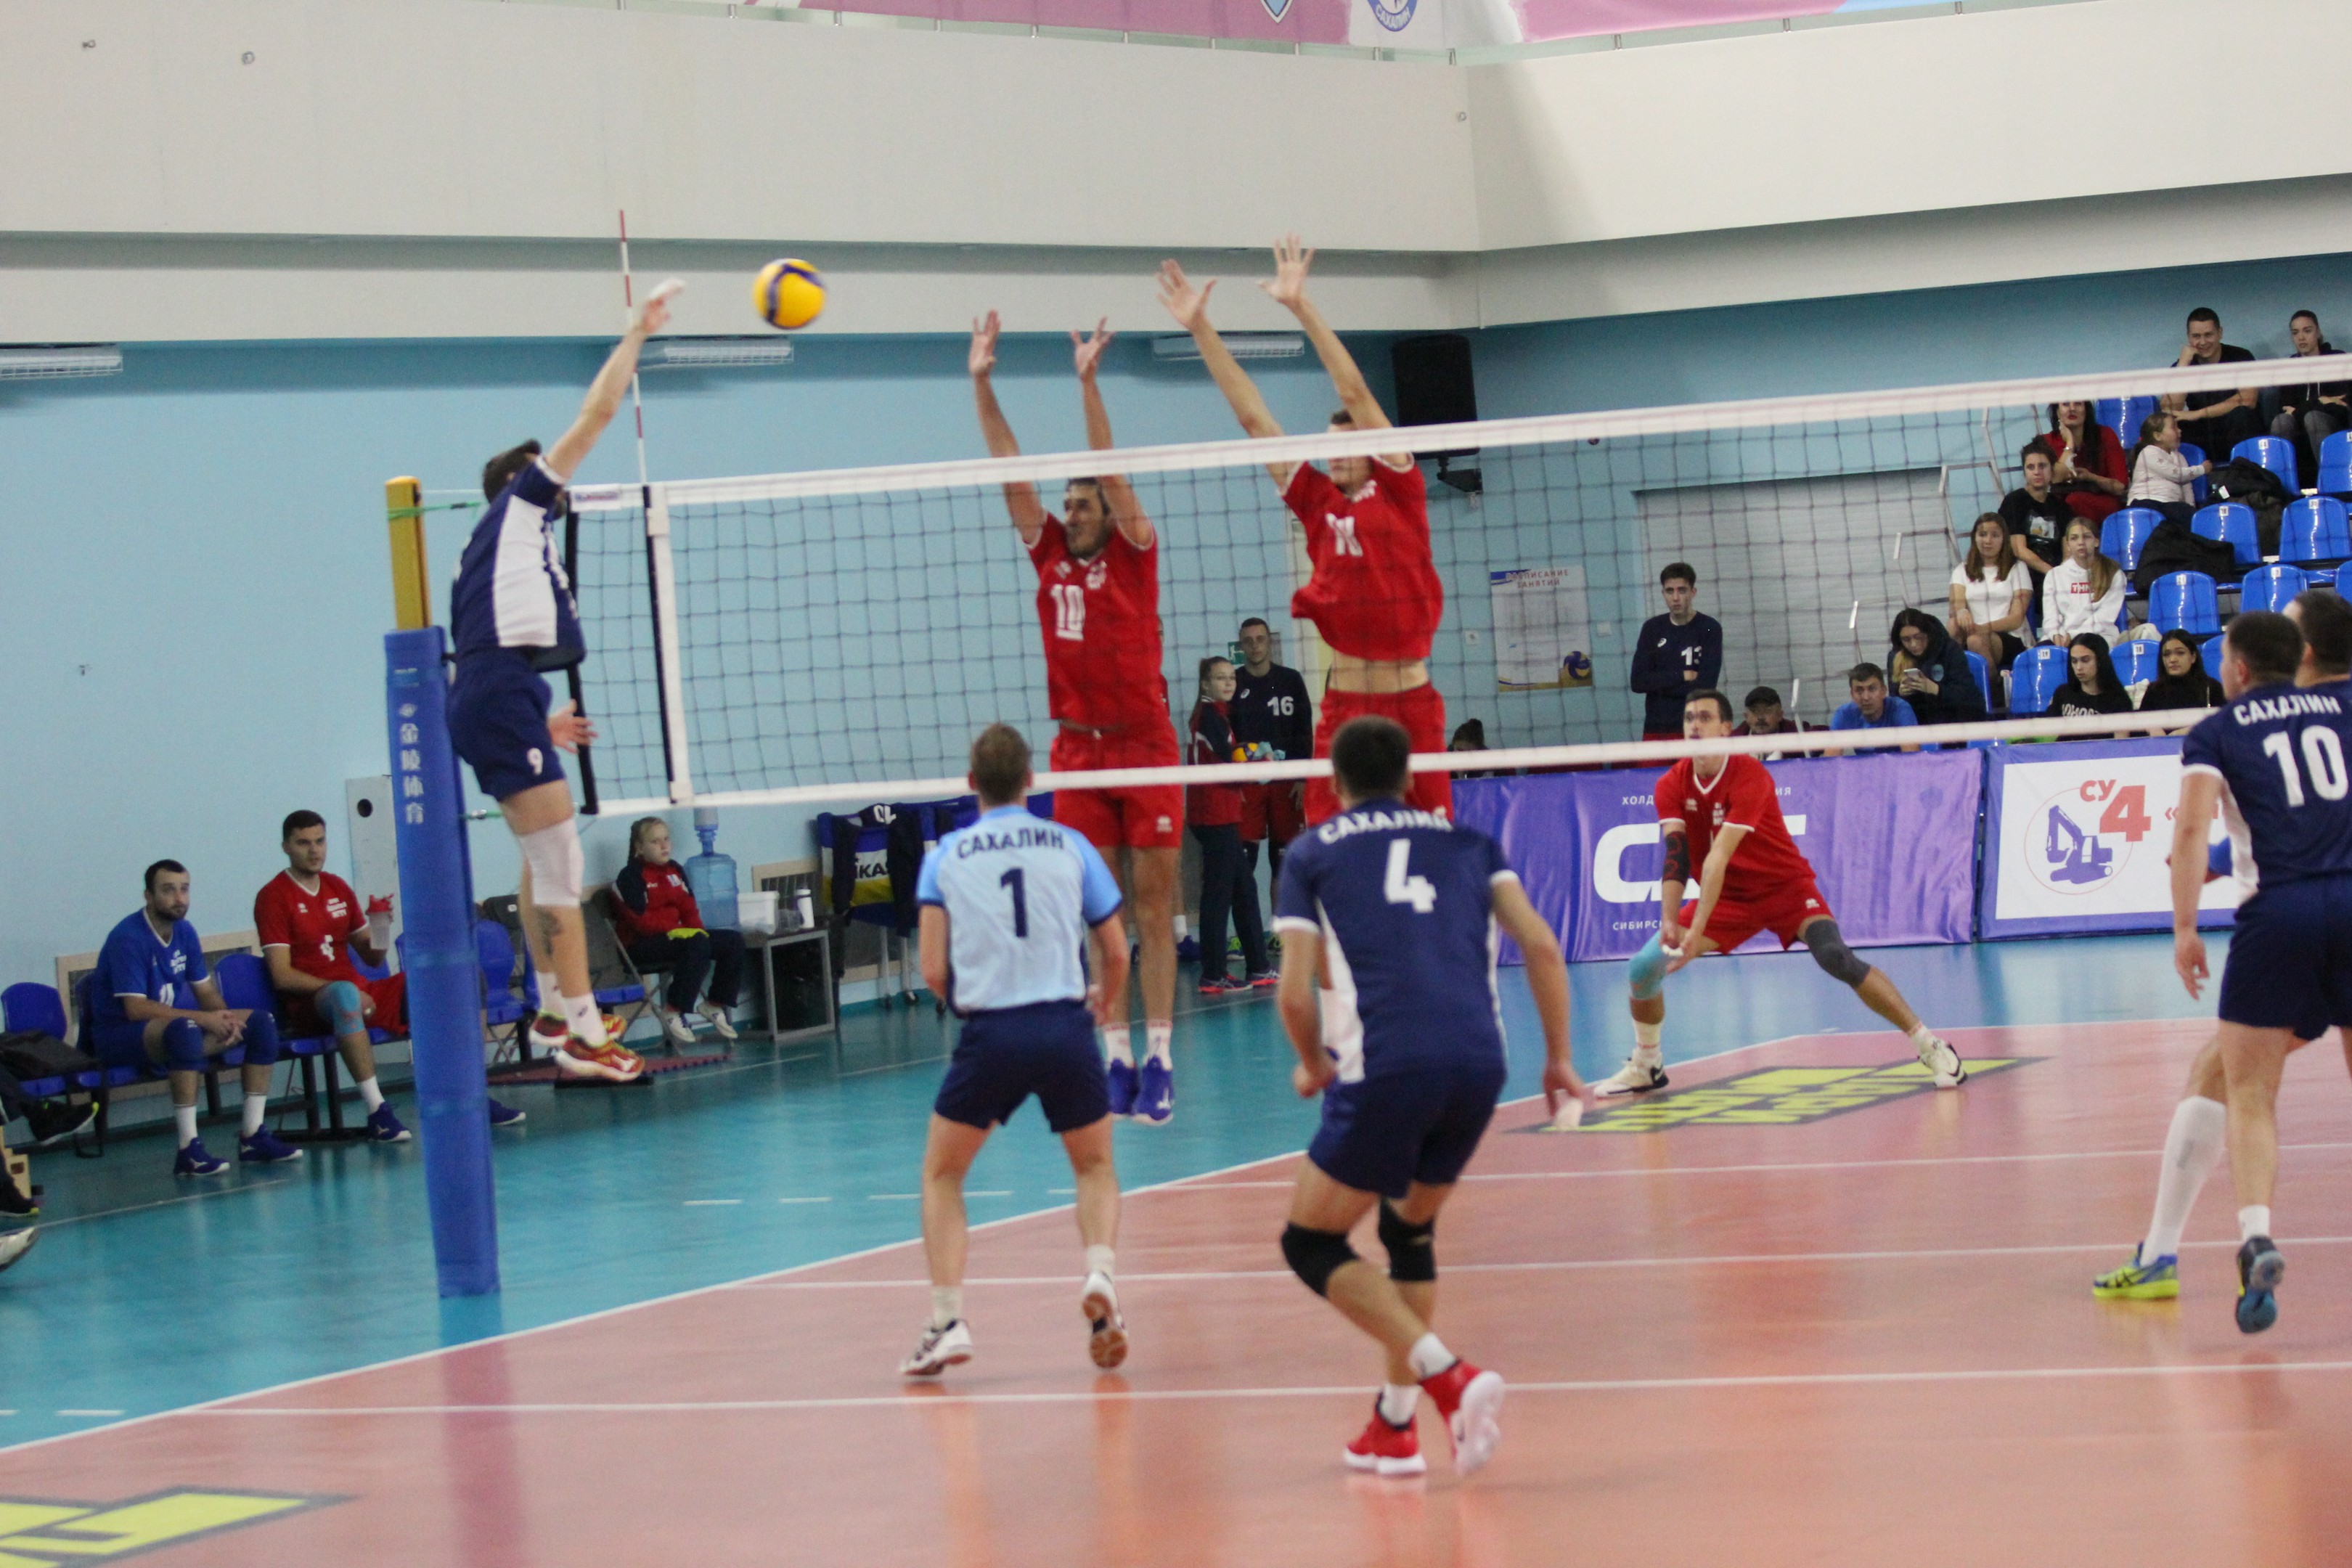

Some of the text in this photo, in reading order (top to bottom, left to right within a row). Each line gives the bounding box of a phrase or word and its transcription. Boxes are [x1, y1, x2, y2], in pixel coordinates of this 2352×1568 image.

[1267, 695, 1294, 716] 16
[2233, 694, 2342, 726] САХАЛИН
[526, 747, 544, 775] 9
[2263, 724, 2349, 808] 10
[1318, 810, 1453, 845] САХАЛИН
[2079, 779, 2117, 801] СУ
[2099, 784, 2152, 843] 4
[957, 827, 1064, 859] САХАЛИН
[1384, 838, 1437, 913] 4
[1000, 867, 1029, 938] 1
[1612, 920, 1663, 931] СИБИРС
